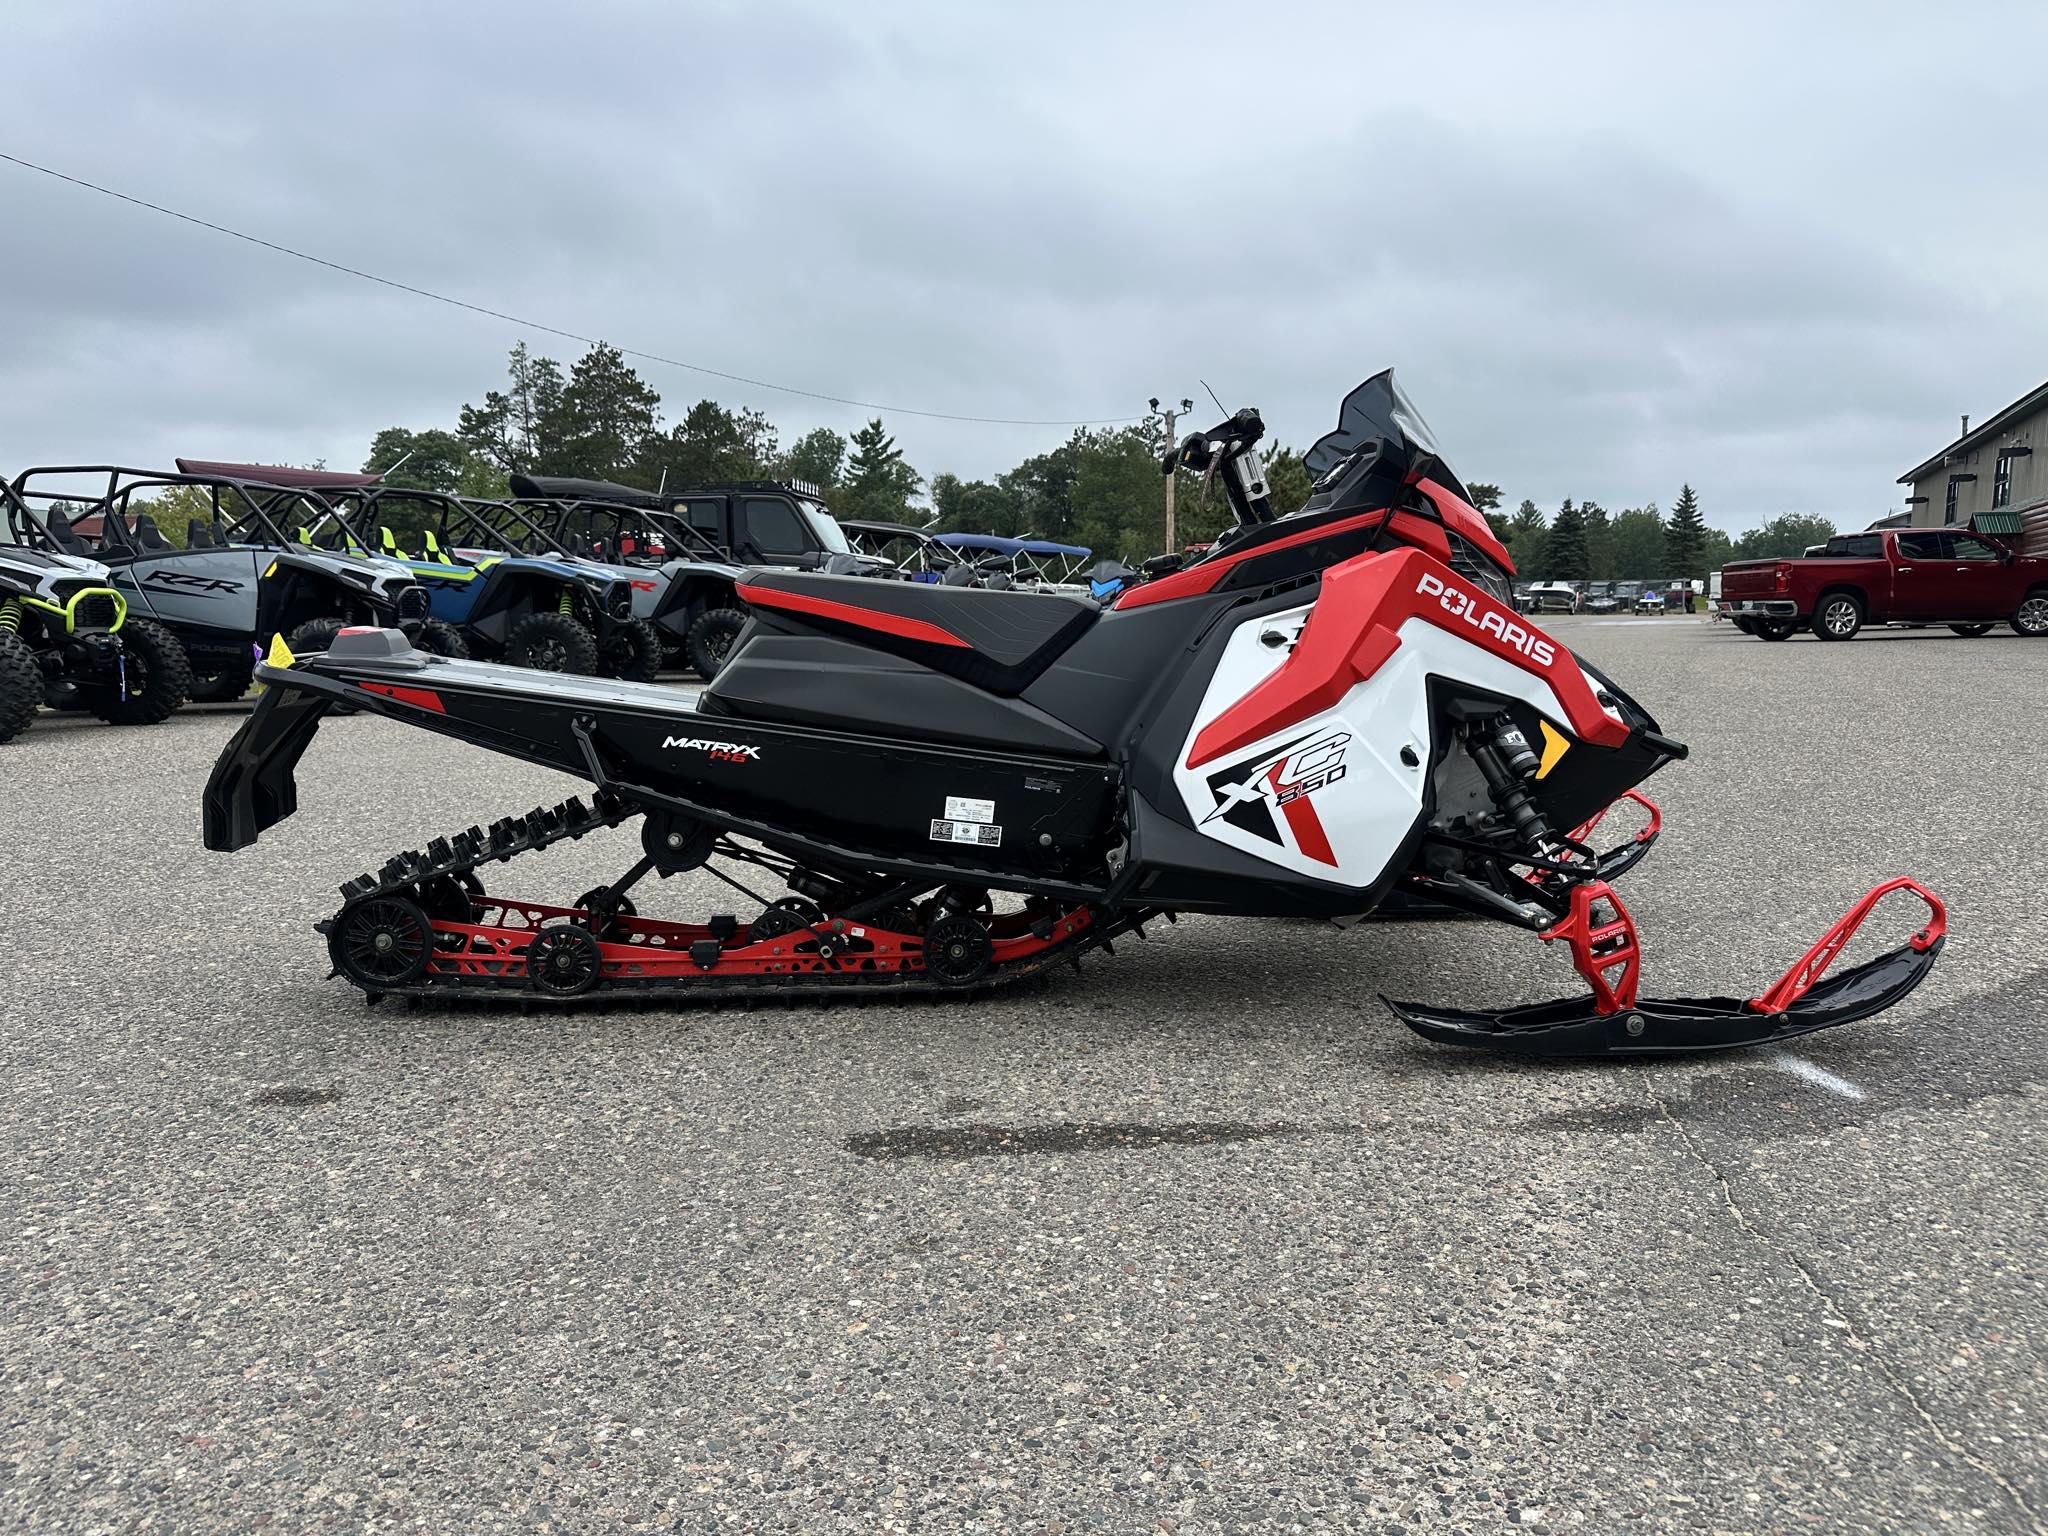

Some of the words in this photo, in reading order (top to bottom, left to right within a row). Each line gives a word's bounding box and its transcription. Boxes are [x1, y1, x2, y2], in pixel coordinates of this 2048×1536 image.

[144, 570, 245, 595] RZR
[1415, 572, 1556, 667] POLARIS
[661, 735, 761, 760] MATRYX
[709, 750, 748, 763] 146
[1198, 731, 1353, 827] XC
[1275, 764, 1347, 807] 850
[1591, 926, 1627, 943] POLARIS
